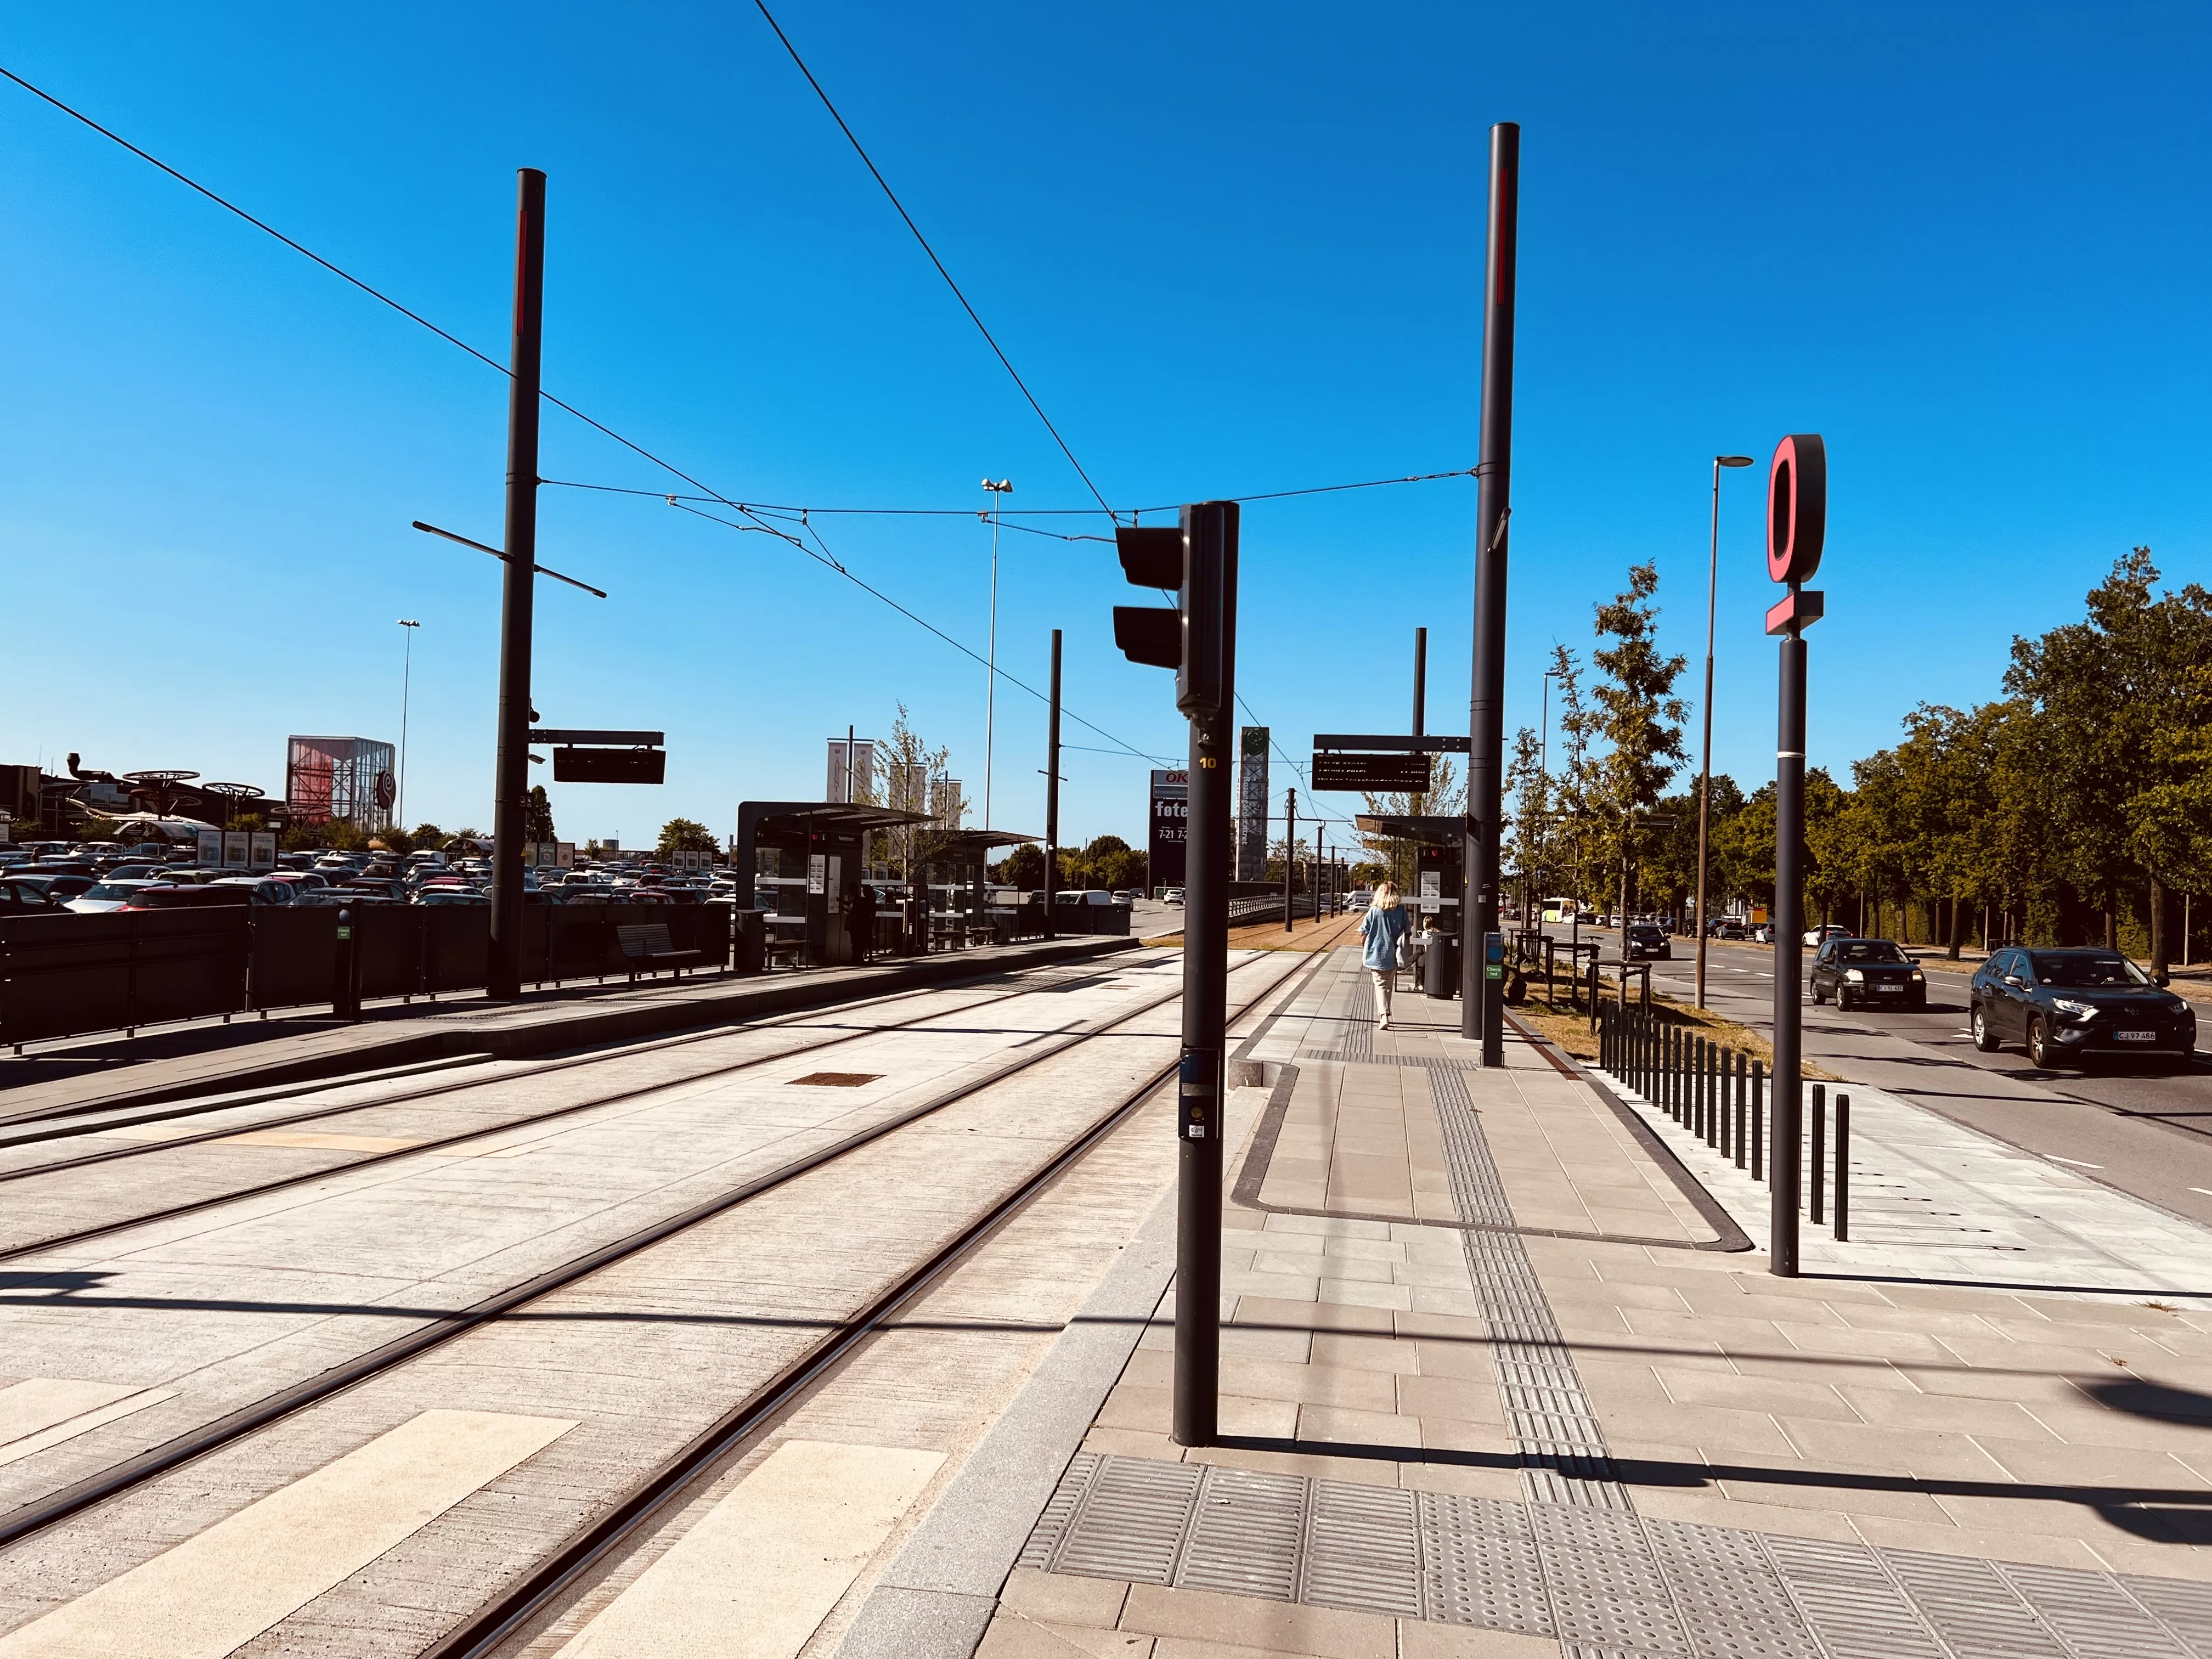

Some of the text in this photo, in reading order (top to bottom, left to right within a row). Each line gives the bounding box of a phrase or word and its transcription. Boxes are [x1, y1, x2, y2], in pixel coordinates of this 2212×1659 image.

[1199, 757, 1216, 769] 10
[1166, 772, 1188, 783] OK
[1159, 830, 1173, 839] 7-21
